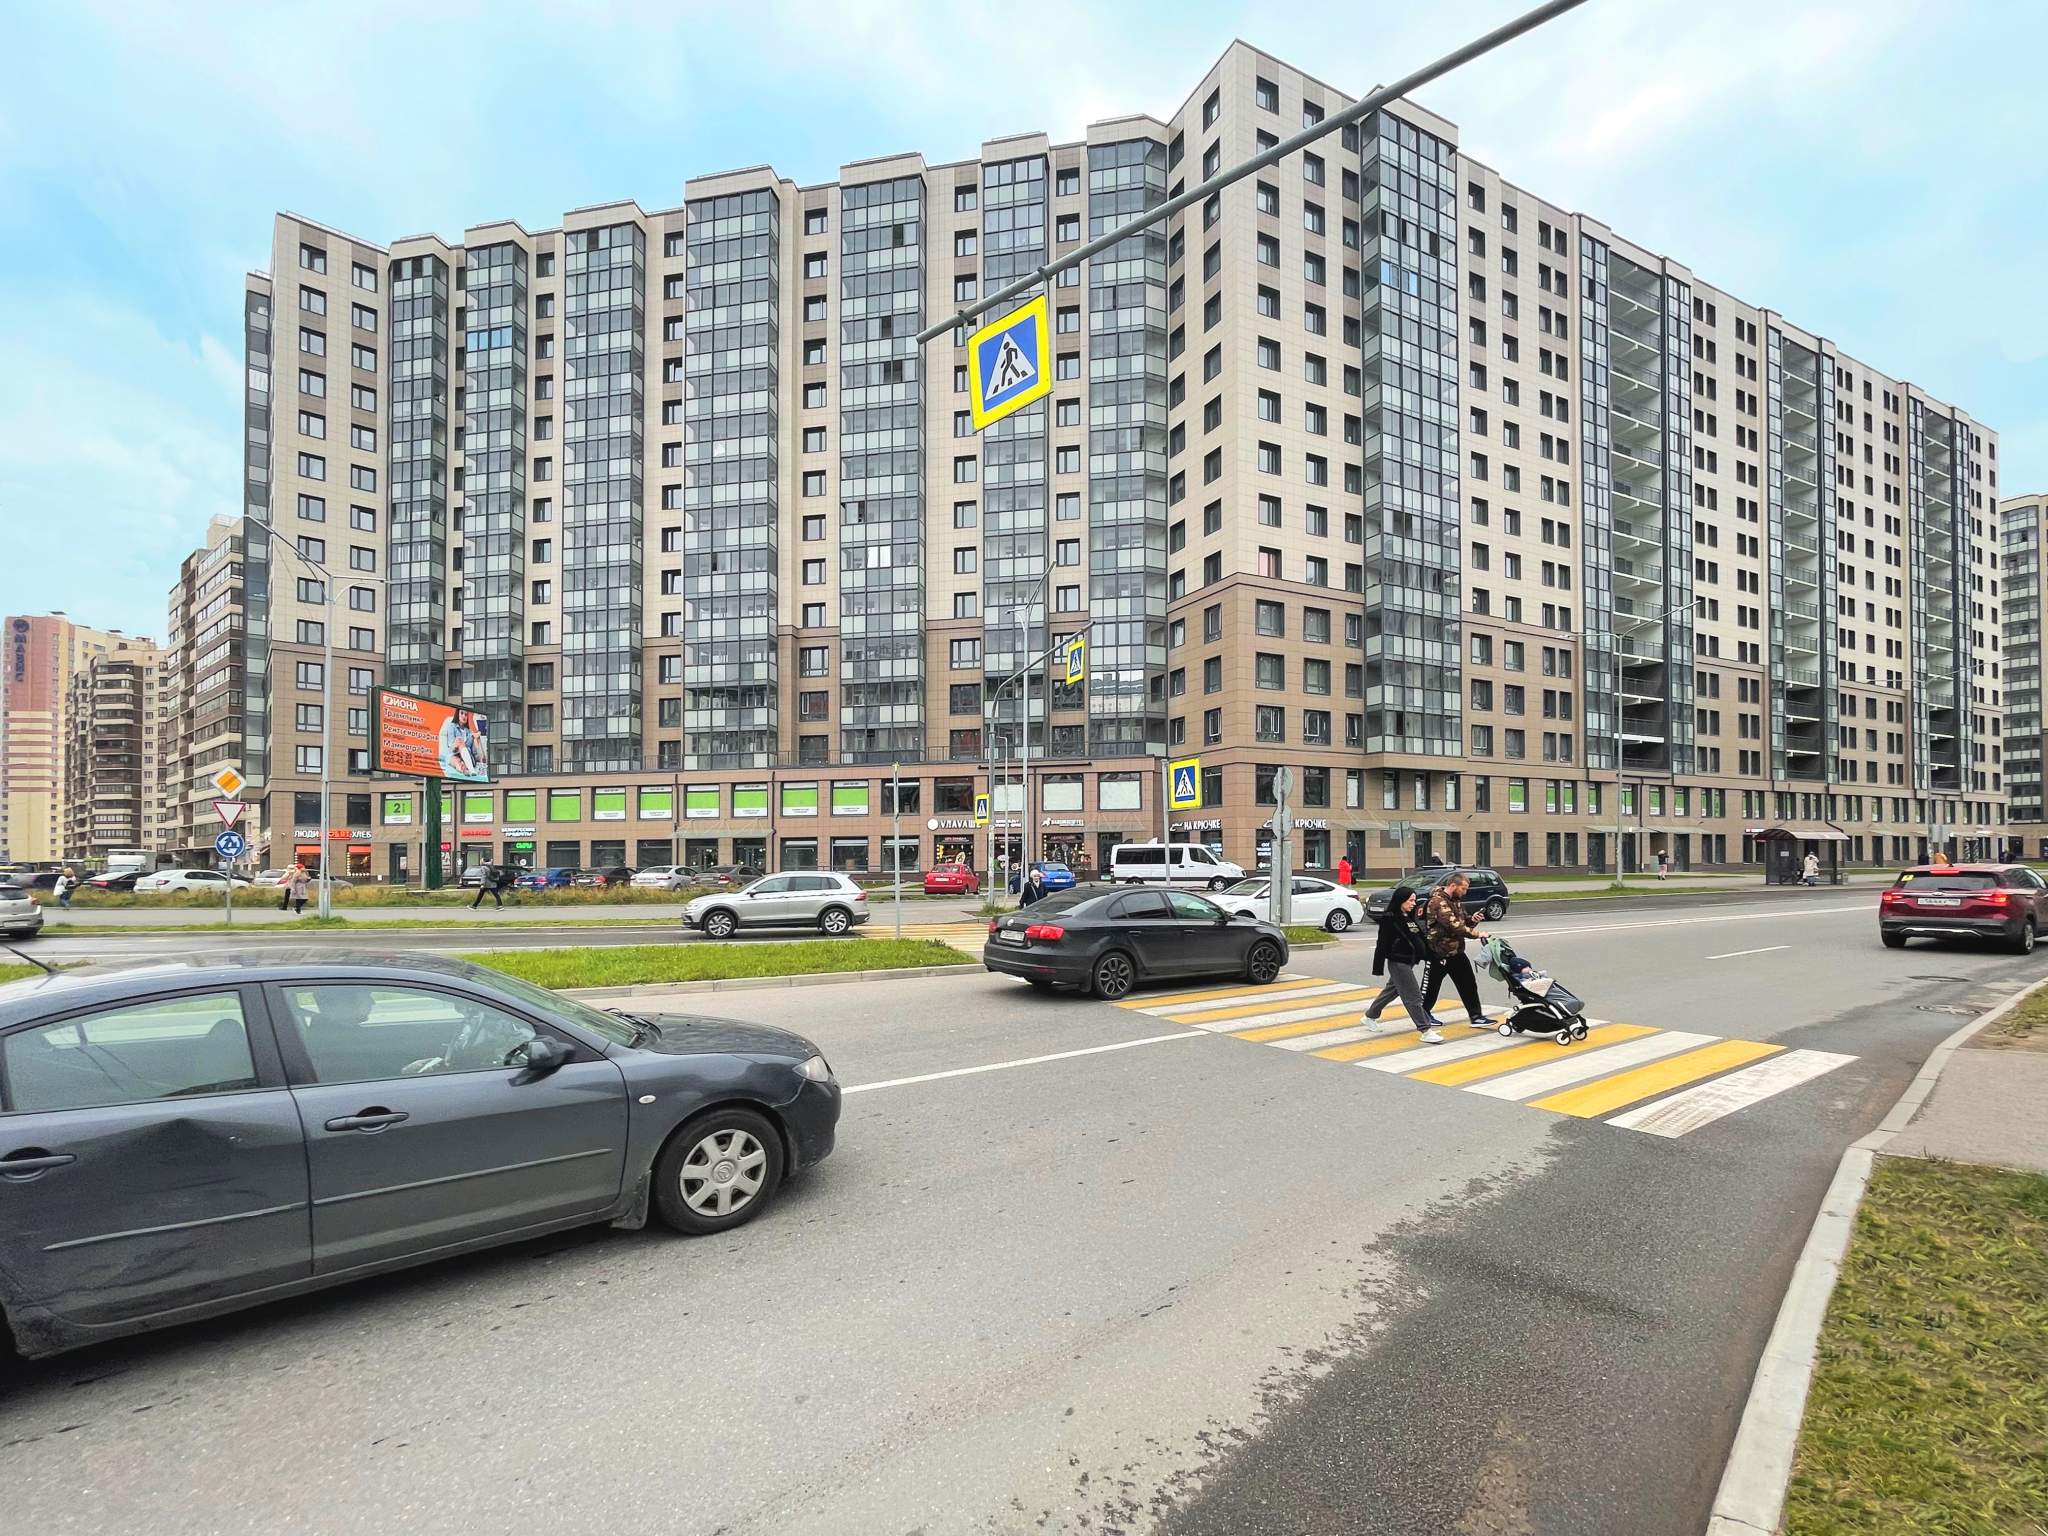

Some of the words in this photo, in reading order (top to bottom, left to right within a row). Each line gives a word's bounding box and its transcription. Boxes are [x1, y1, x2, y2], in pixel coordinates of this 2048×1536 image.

[393, 803, 401, 813] 2
[1184, 821, 1193, 830] НА
[1193, 819, 1222, 830] КРЮЧКЕ
[1295, 819, 1327, 828] КРЮЧКЕ
[294, 830, 319, 838] ЛЮДИ
